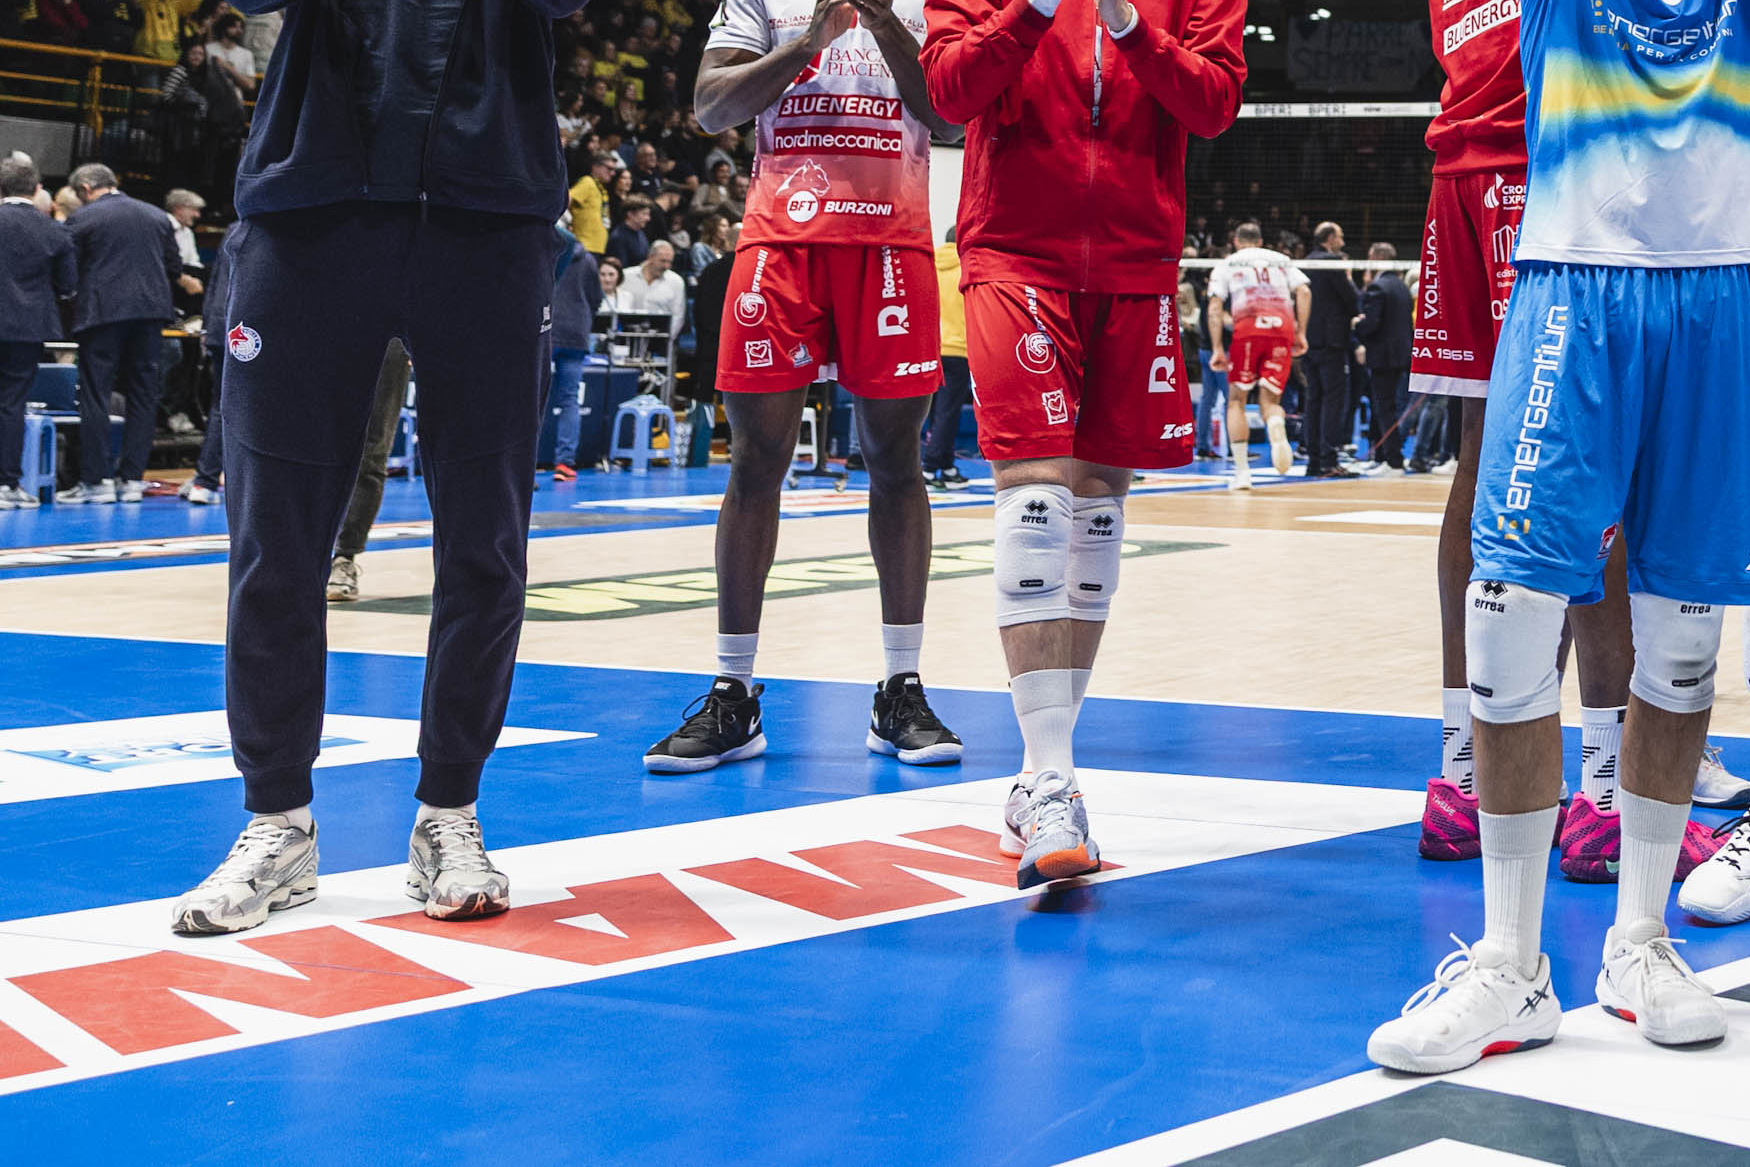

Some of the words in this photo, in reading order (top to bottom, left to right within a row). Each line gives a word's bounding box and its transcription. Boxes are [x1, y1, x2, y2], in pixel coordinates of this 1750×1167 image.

[827, 62, 891, 77] PIACEN
[781, 96, 898, 118] BLUENERGY
[775, 130, 903, 152] nordmeccanica
[788, 200, 817, 212] BFT
[823, 200, 893, 216] BURZONI
[894, 360, 939, 377] Zeus
